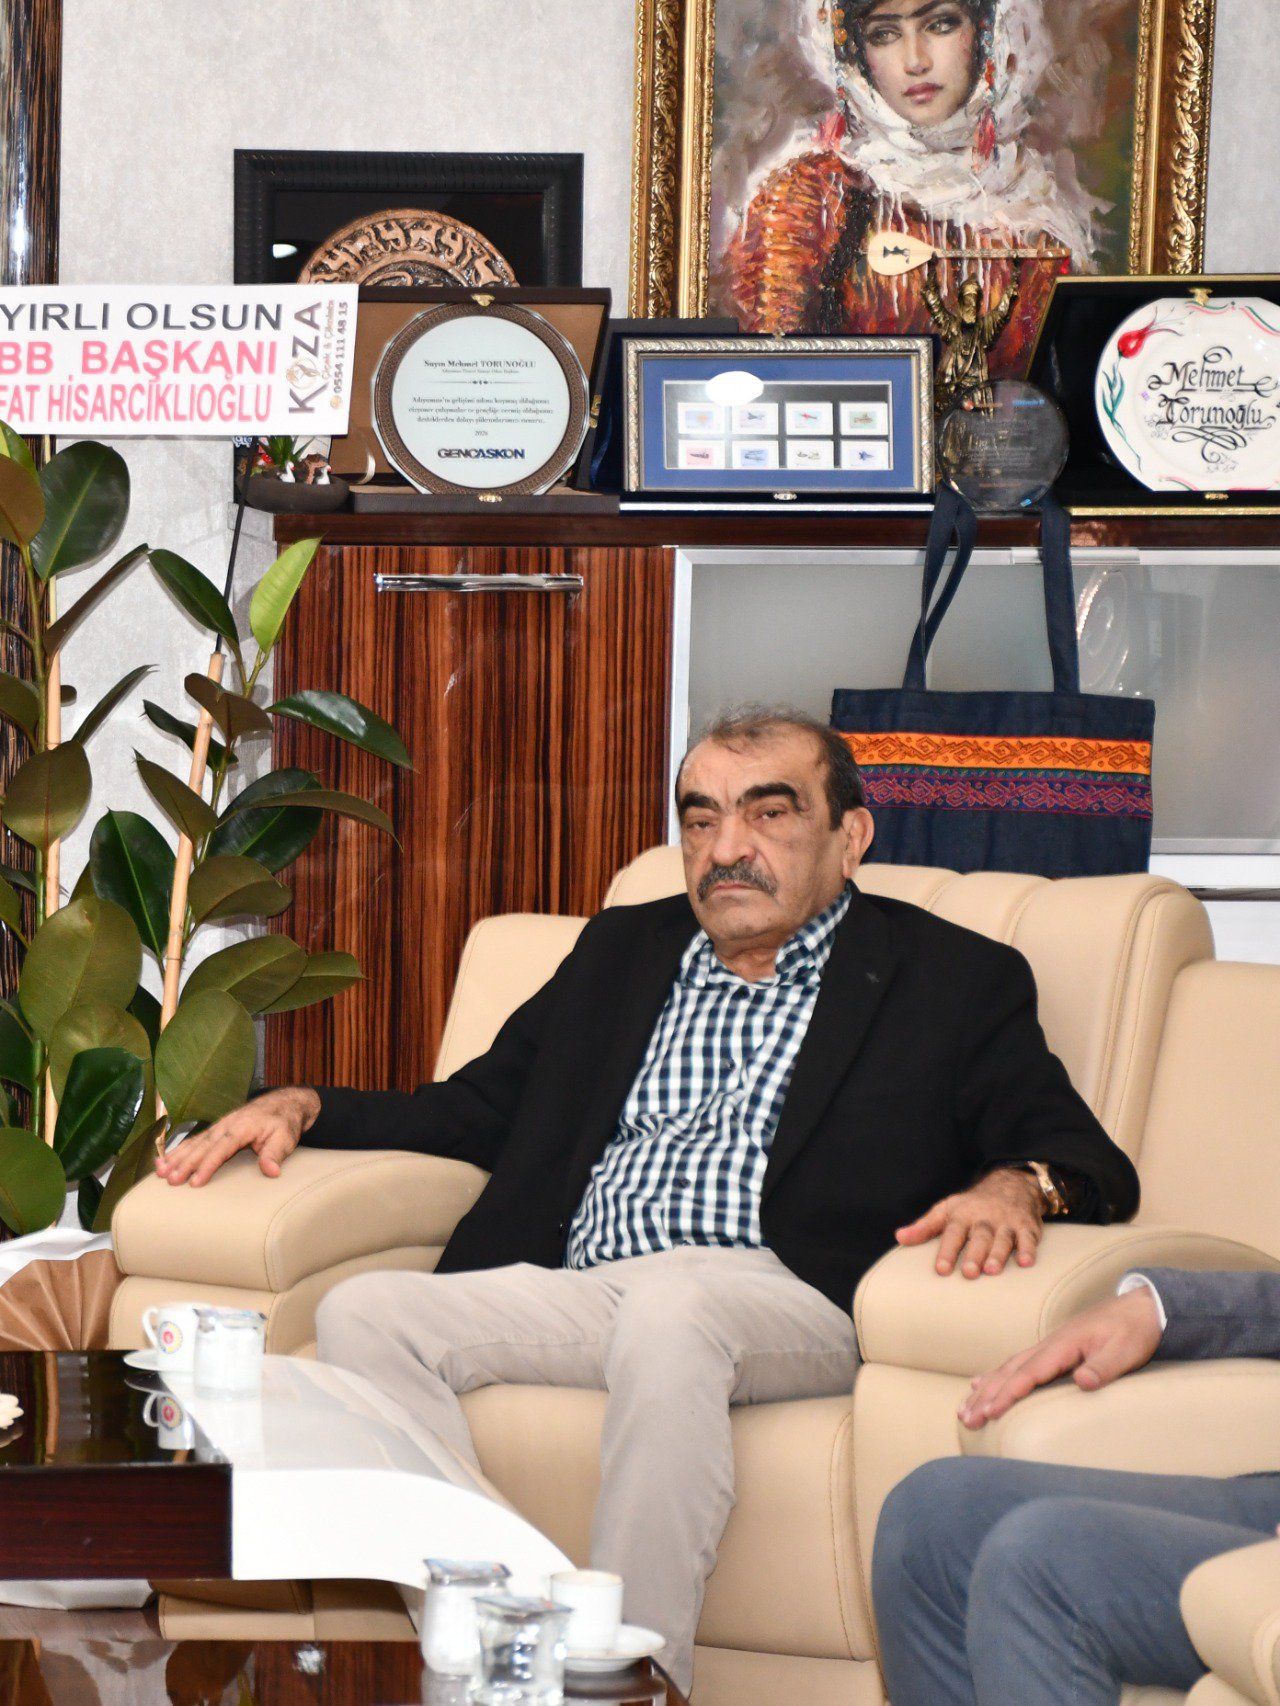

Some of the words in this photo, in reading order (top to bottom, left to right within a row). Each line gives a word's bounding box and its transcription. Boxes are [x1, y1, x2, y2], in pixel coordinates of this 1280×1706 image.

[126, 302, 282, 331] OLSUN
[81, 340, 277, 382] BAŞKANI
[1153, 348, 1259, 392] Mehmet
[1158, 394, 1274, 430] Torunoğlu
